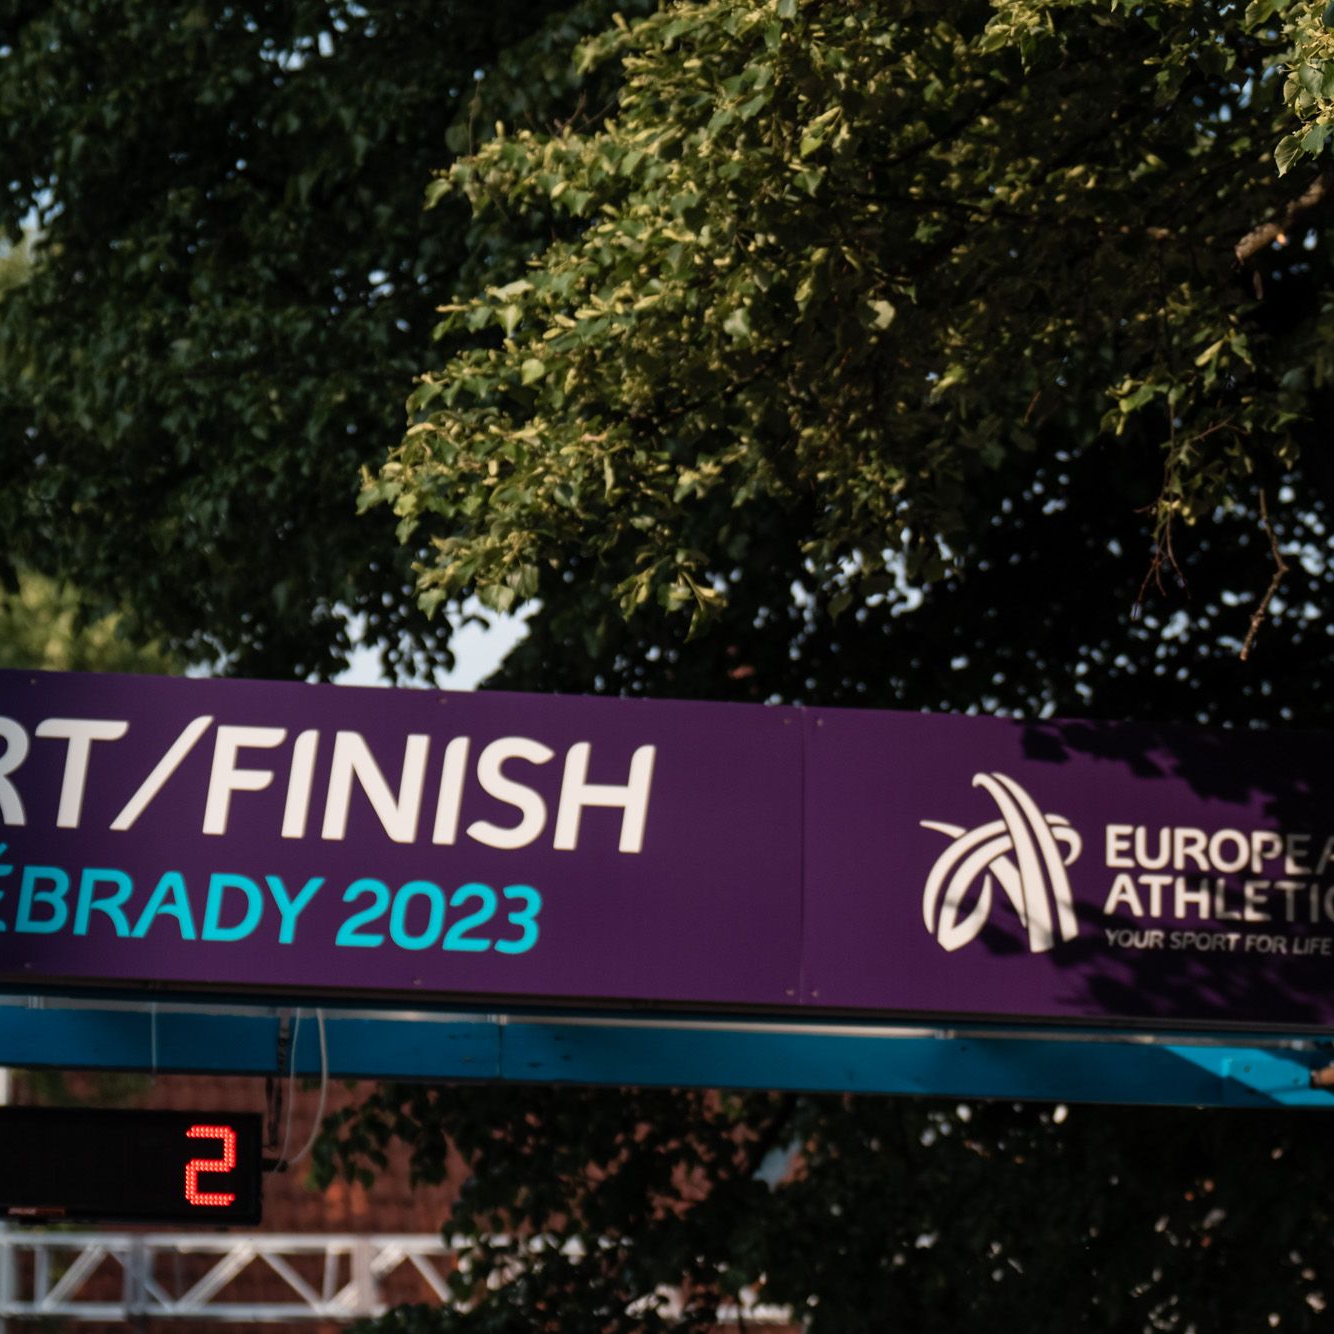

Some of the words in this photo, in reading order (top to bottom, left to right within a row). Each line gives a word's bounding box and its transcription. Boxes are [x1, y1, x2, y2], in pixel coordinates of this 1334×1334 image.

[335, 877, 542, 954] 2023
[1105, 929, 1164, 949] YOUR
[1169, 932, 1241, 951] SPORT
[1245, 933, 1287, 954] FOR
[1292, 936, 1332, 956] LIFE
[186, 1125, 236, 1206] 2
